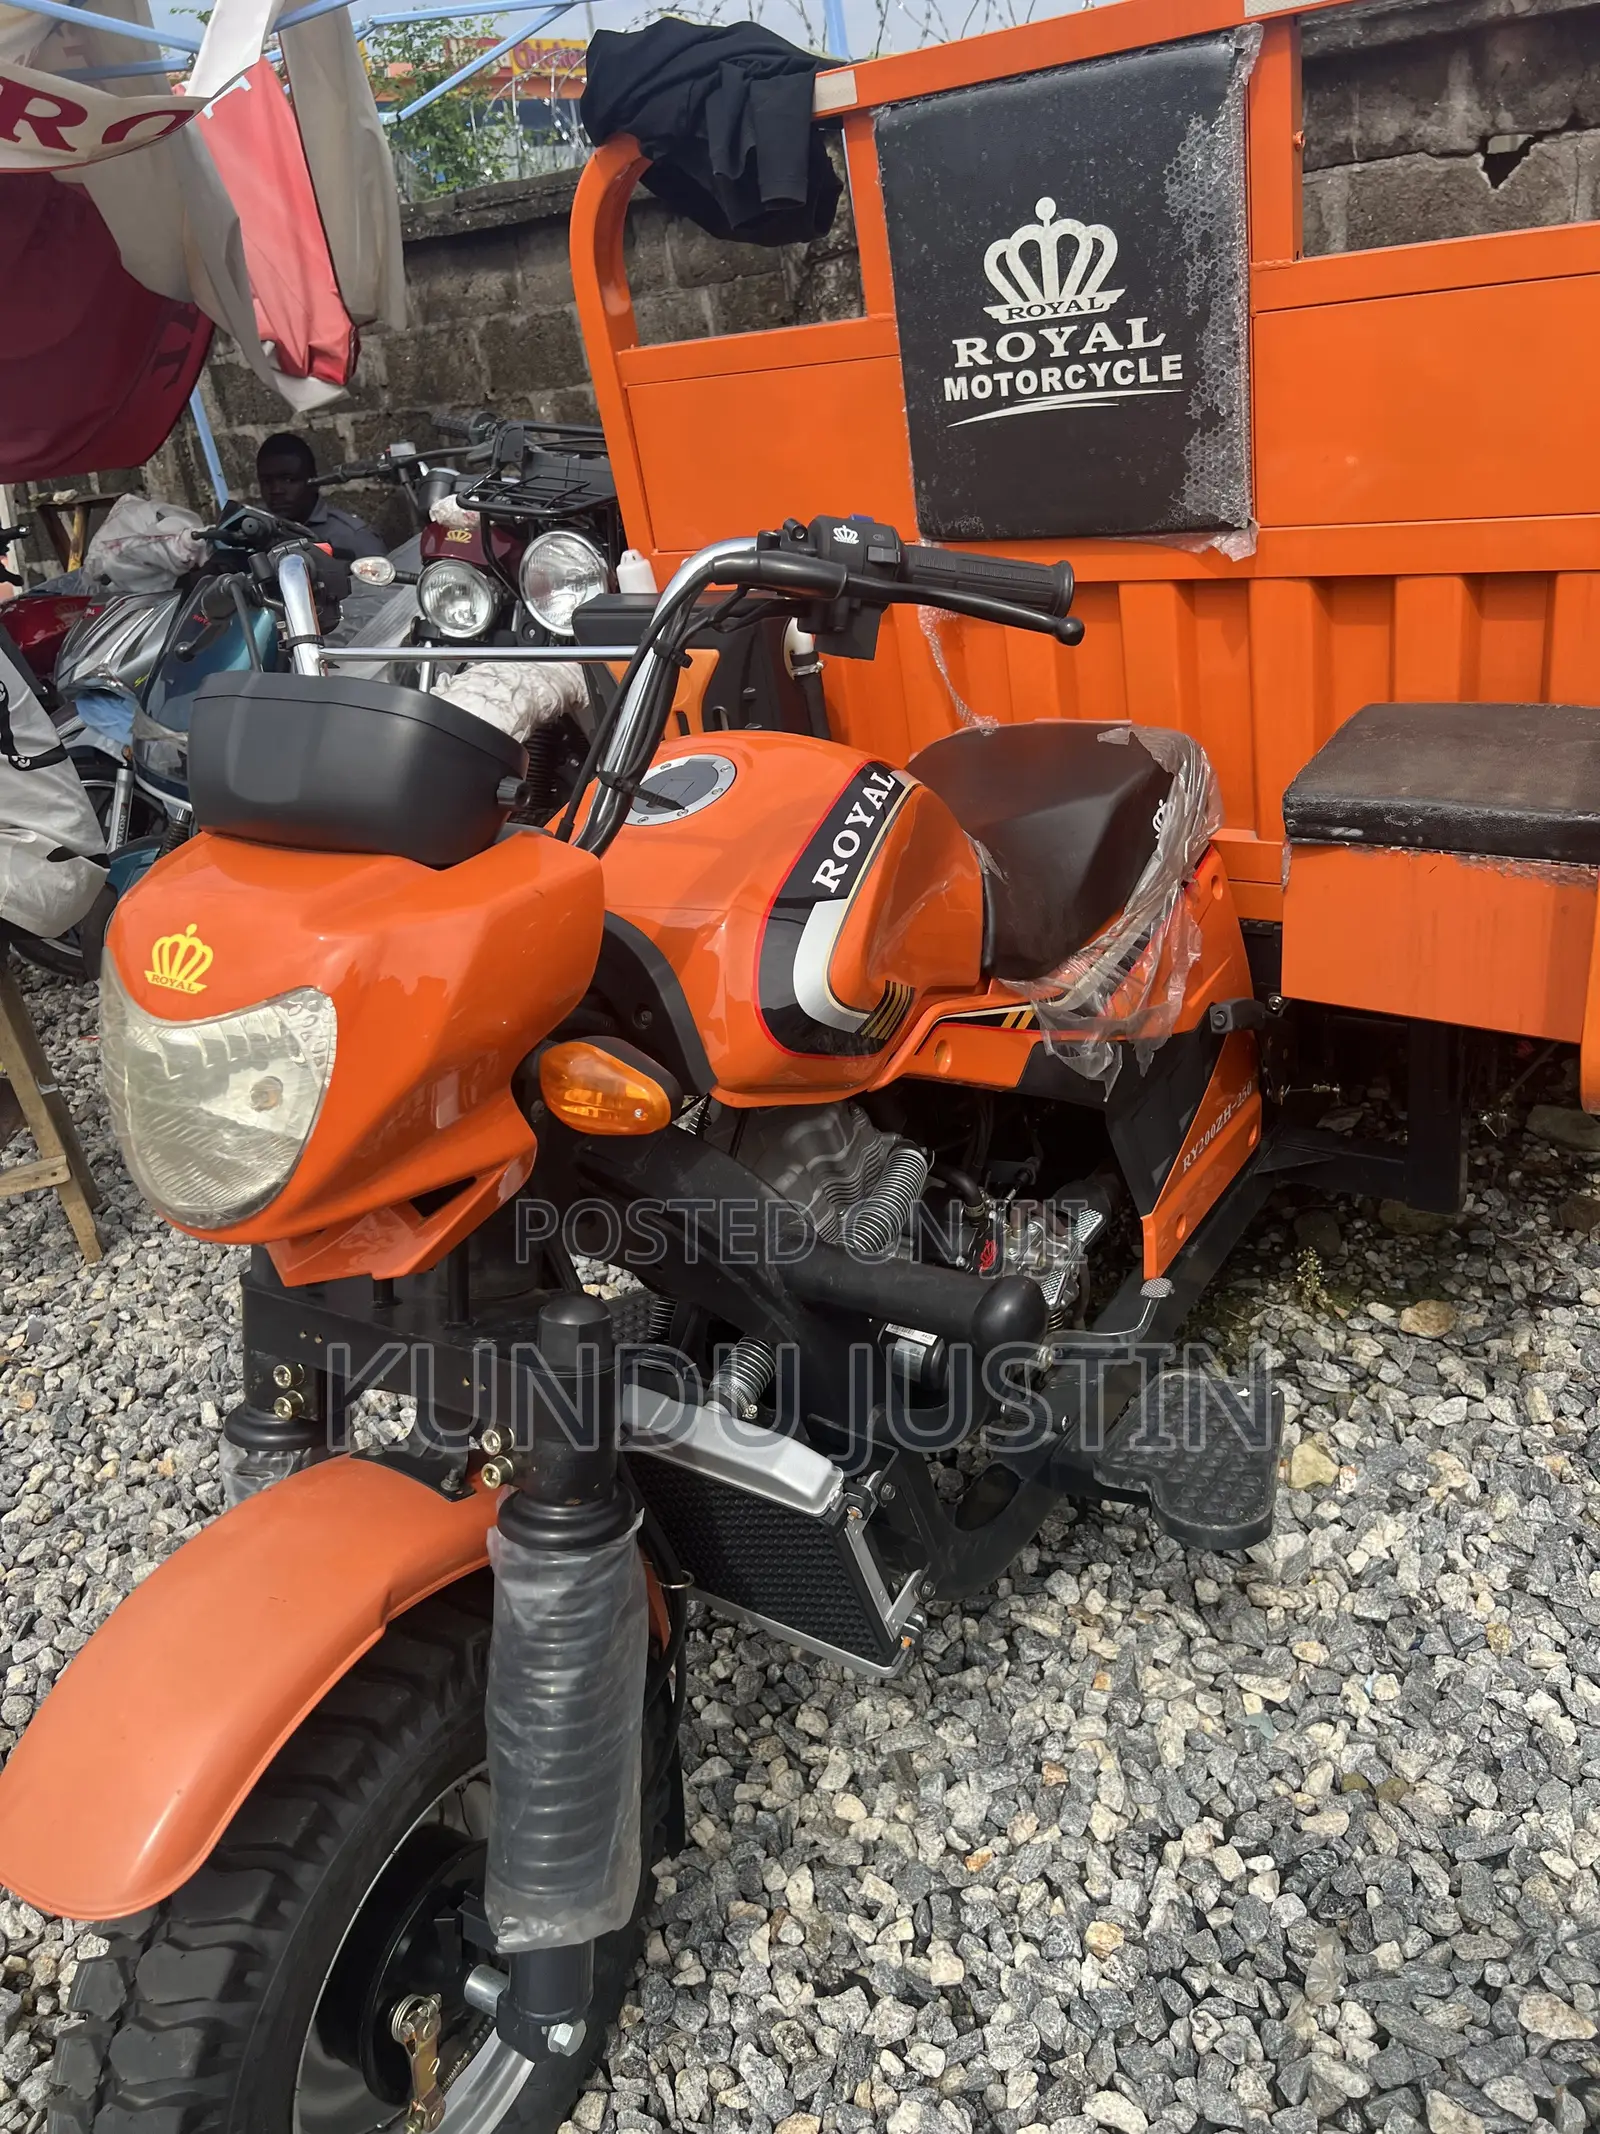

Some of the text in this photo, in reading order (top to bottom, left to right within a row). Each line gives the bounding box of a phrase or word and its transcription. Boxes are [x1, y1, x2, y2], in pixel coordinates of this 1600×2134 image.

[1005, 296, 1106, 322] ROYAL
[951, 316, 1167, 368] ROYAL
[943, 354, 1184, 402] MOTORCYCLE
[811, 771, 896, 894] ROYAL
[151, 974, 195, 992] ROYAL
[1181, 1080, 1252, 1174] RY200ZH-250
